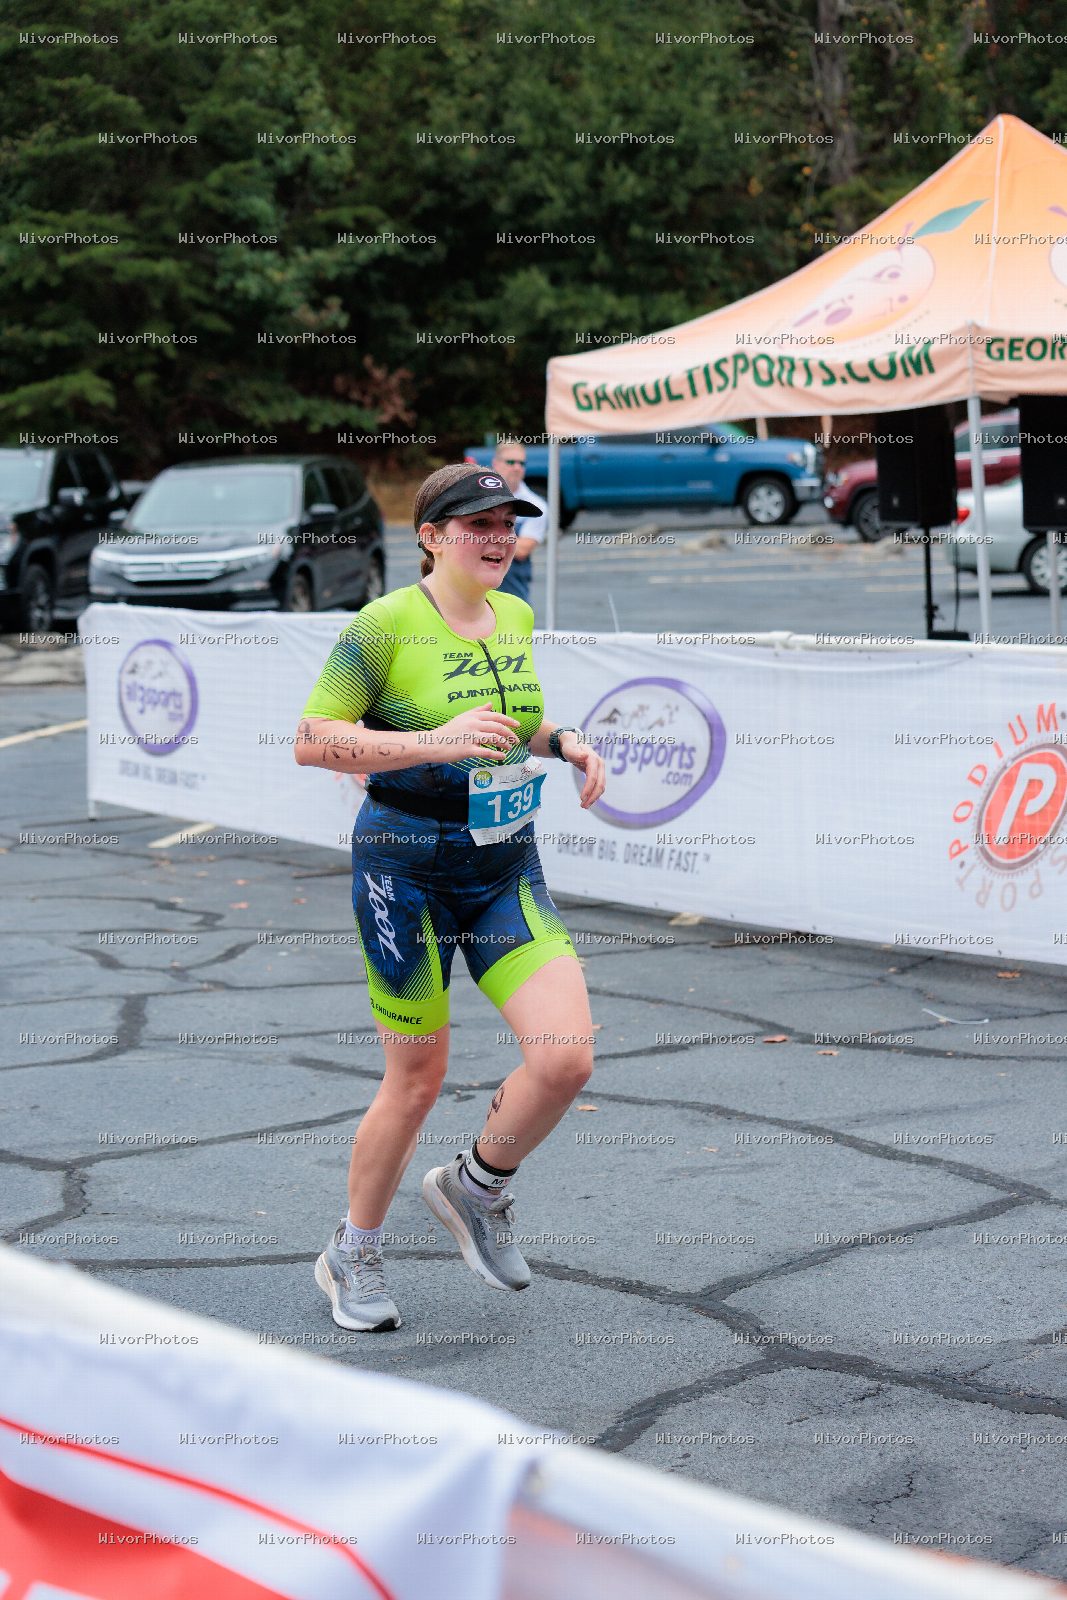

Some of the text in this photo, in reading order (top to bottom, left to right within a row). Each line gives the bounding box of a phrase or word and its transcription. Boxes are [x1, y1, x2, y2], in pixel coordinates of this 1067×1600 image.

[571, 341, 936, 413] GAMULTISPORTS.COM
[442, 652, 474, 660] TEAM
[512, 705, 541, 714] HED
[948, 702, 1060, 861] PODIUM
[487, 782, 534, 823] 139
[996, 762, 1057, 845] P
[623, 843, 665, 870] DREAM
[384, 875, 396, 902] TEAM
[375, 1003, 424, 1025] ENDURANCE
